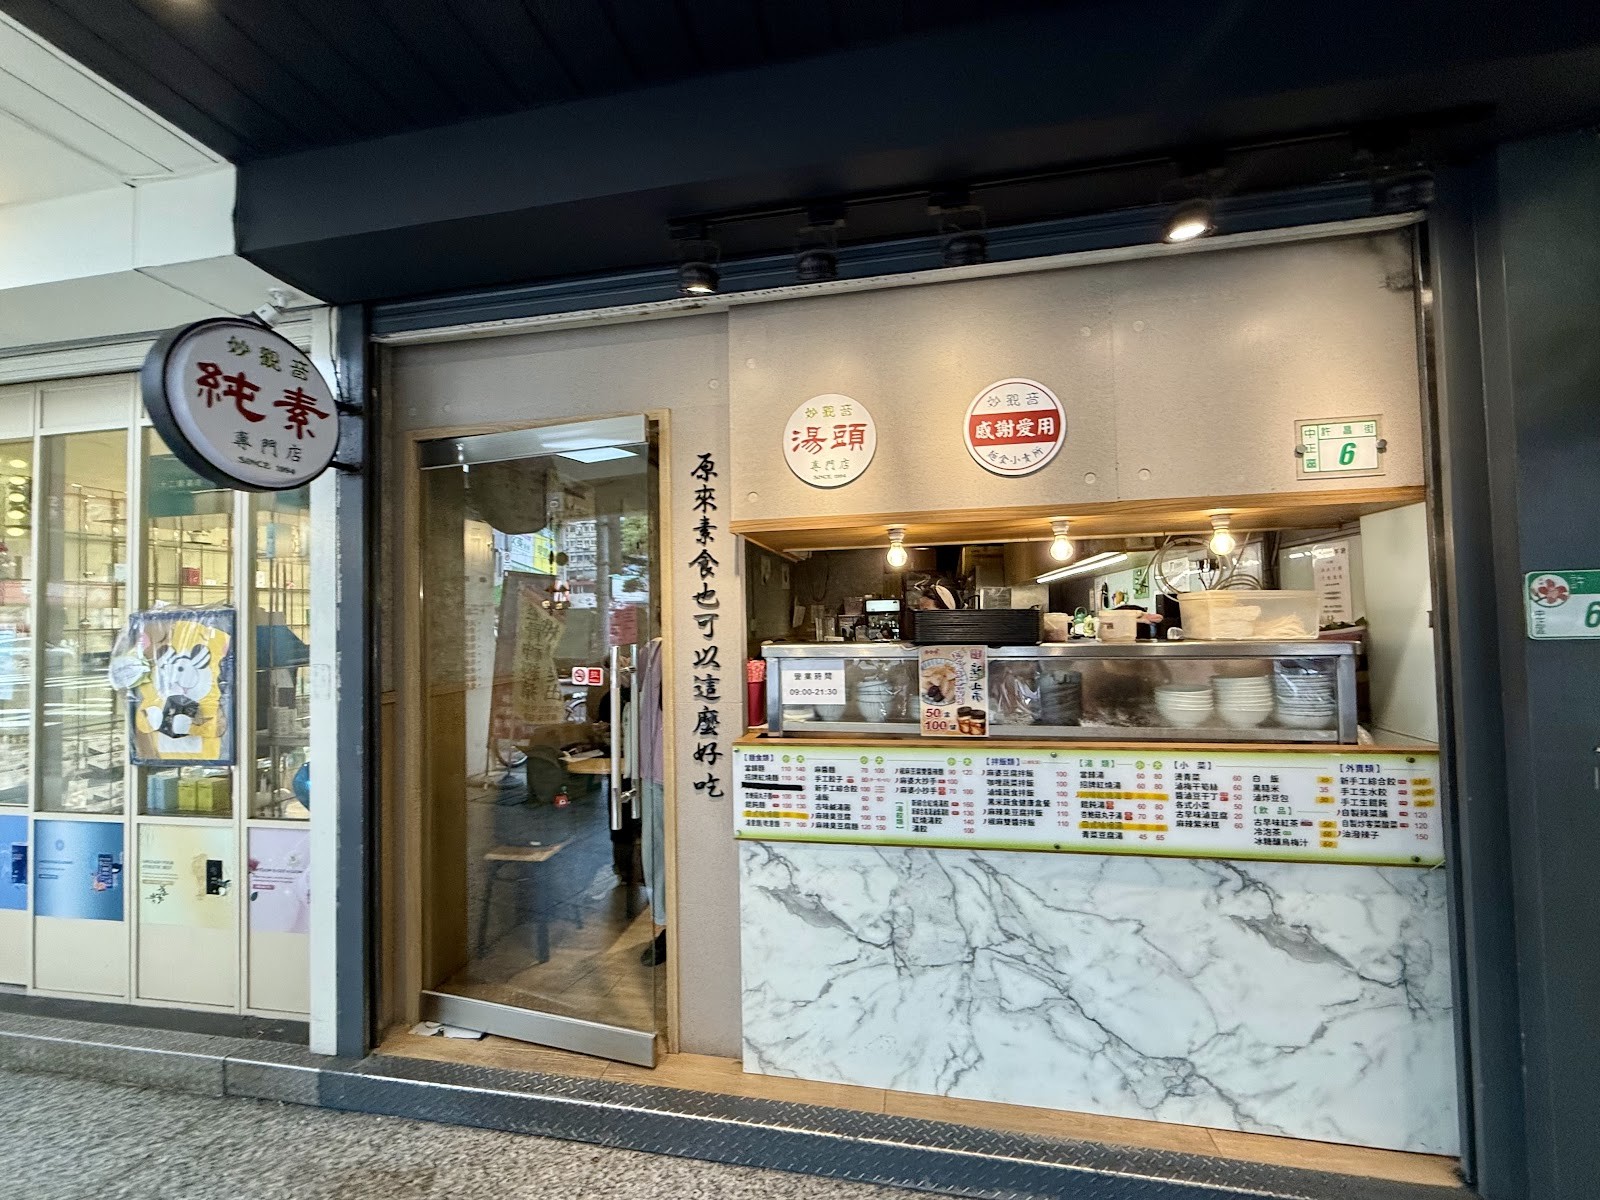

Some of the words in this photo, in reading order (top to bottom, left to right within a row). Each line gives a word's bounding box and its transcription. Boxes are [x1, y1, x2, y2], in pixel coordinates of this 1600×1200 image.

[227, 336, 309, 381] 妙觀音
[196, 361, 330, 439] 純素
[987, 393, 1038, 408] 妙觀音
[804, 404, 853, 418] 妙觀音
[974, 418, 1054, 440] 感謝愛用
[792, 423, 868, 455] 湯頭
[233, 431, 302, 462] 專門店
[1339, 442, 1357, 465] 6
[238, 456, 272, 470] SINCE
[810, 460, 850, 472] 專門店
[689, 452, 724, 801] 原來素食也可以這麼好吃
[794, 672, 833, 681] 營業時間
[789, 688, 837, 696] 09:00-21:30
[925, 708, 941, 718] 50
[925, 721, 947, 731] 100
[1340, 777, 1396, 786] 新手工綜合餃
[1340, 788, 1387, 796] 手工生水餃
[1341, 798, 1388, 807] 手工生餛飩
[1254, 819, 1298, 827] 古早味紅茶
[1254, 828, 1281, 836] 冷泡茶
